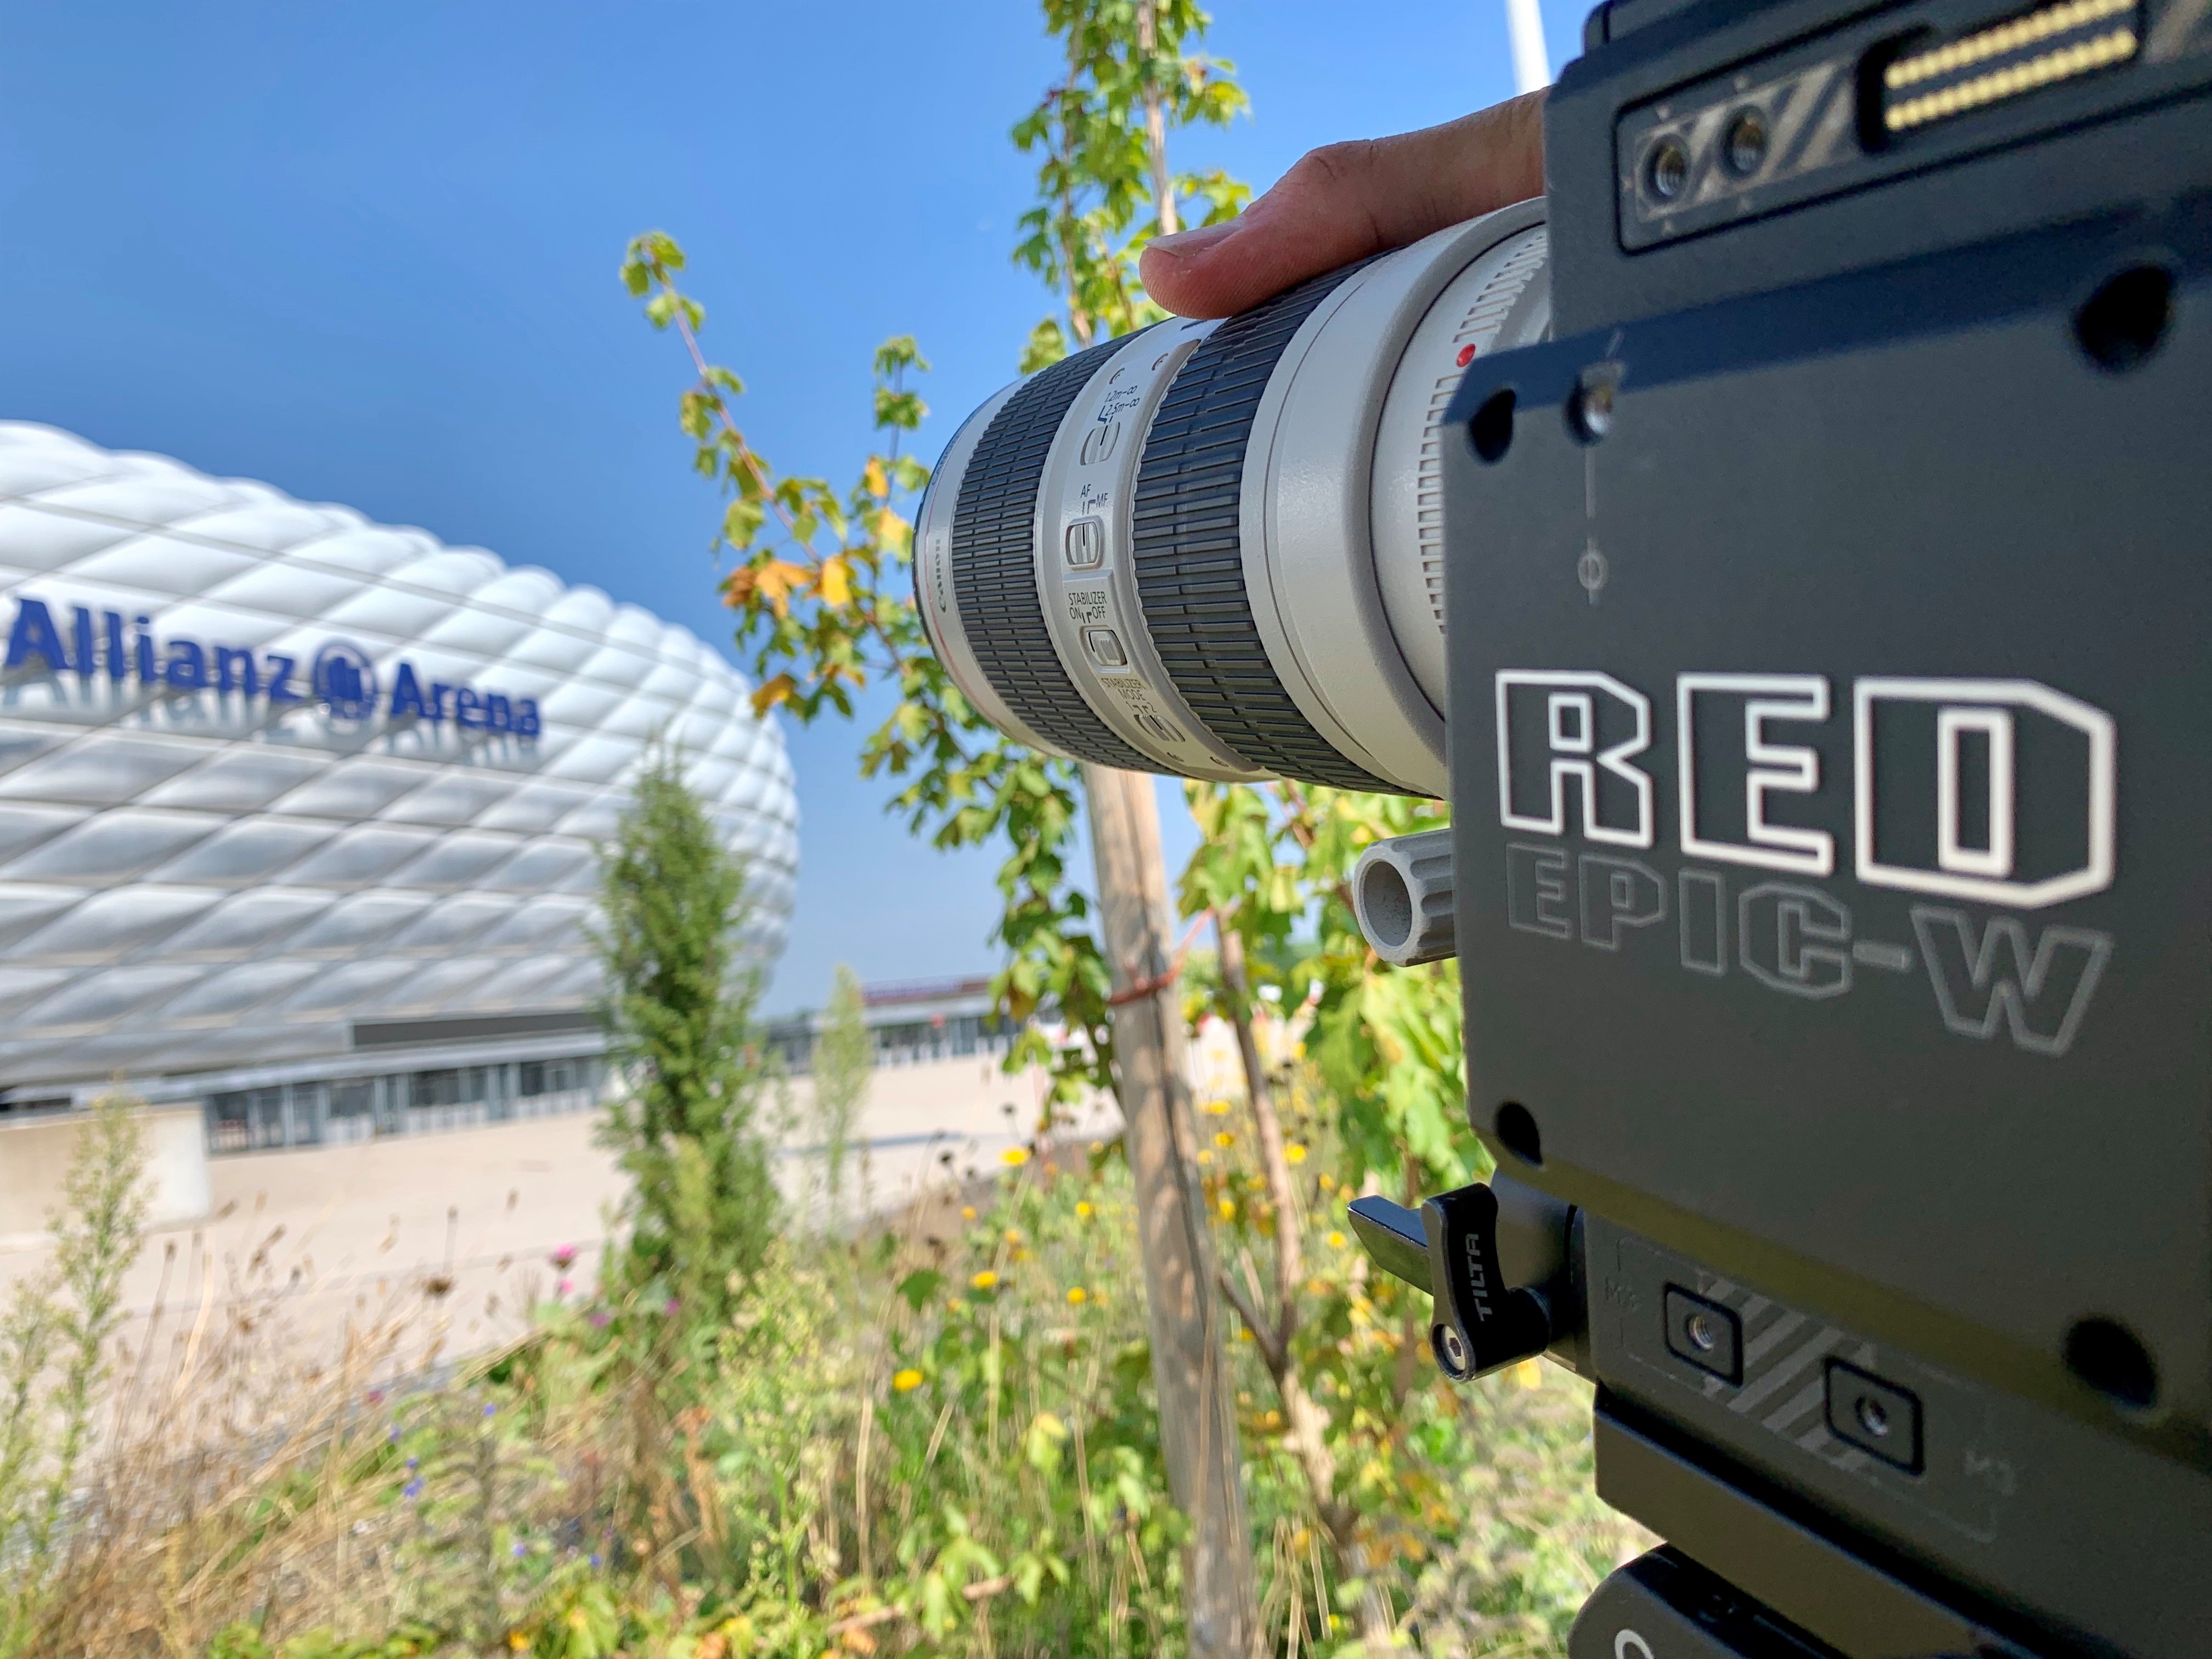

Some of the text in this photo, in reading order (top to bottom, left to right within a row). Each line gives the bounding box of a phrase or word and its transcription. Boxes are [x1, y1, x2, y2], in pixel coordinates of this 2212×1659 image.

[1080, 483, 1091, 499] AF
[1096, 492, 1108, 508] MF
[1068, 591, 1108, 606] STABILIZER
[1069, 606, 1106, 619] ON OFF
[7, 596, 541, 738] Allianz Arena
[1118, 689, 1146, 701] MODE
[1495, 668, 2119, 909] RED
[1504, 841, 2117, 1059] EPIC-W
[1465, 1233, 1493, 1322] TILTA
